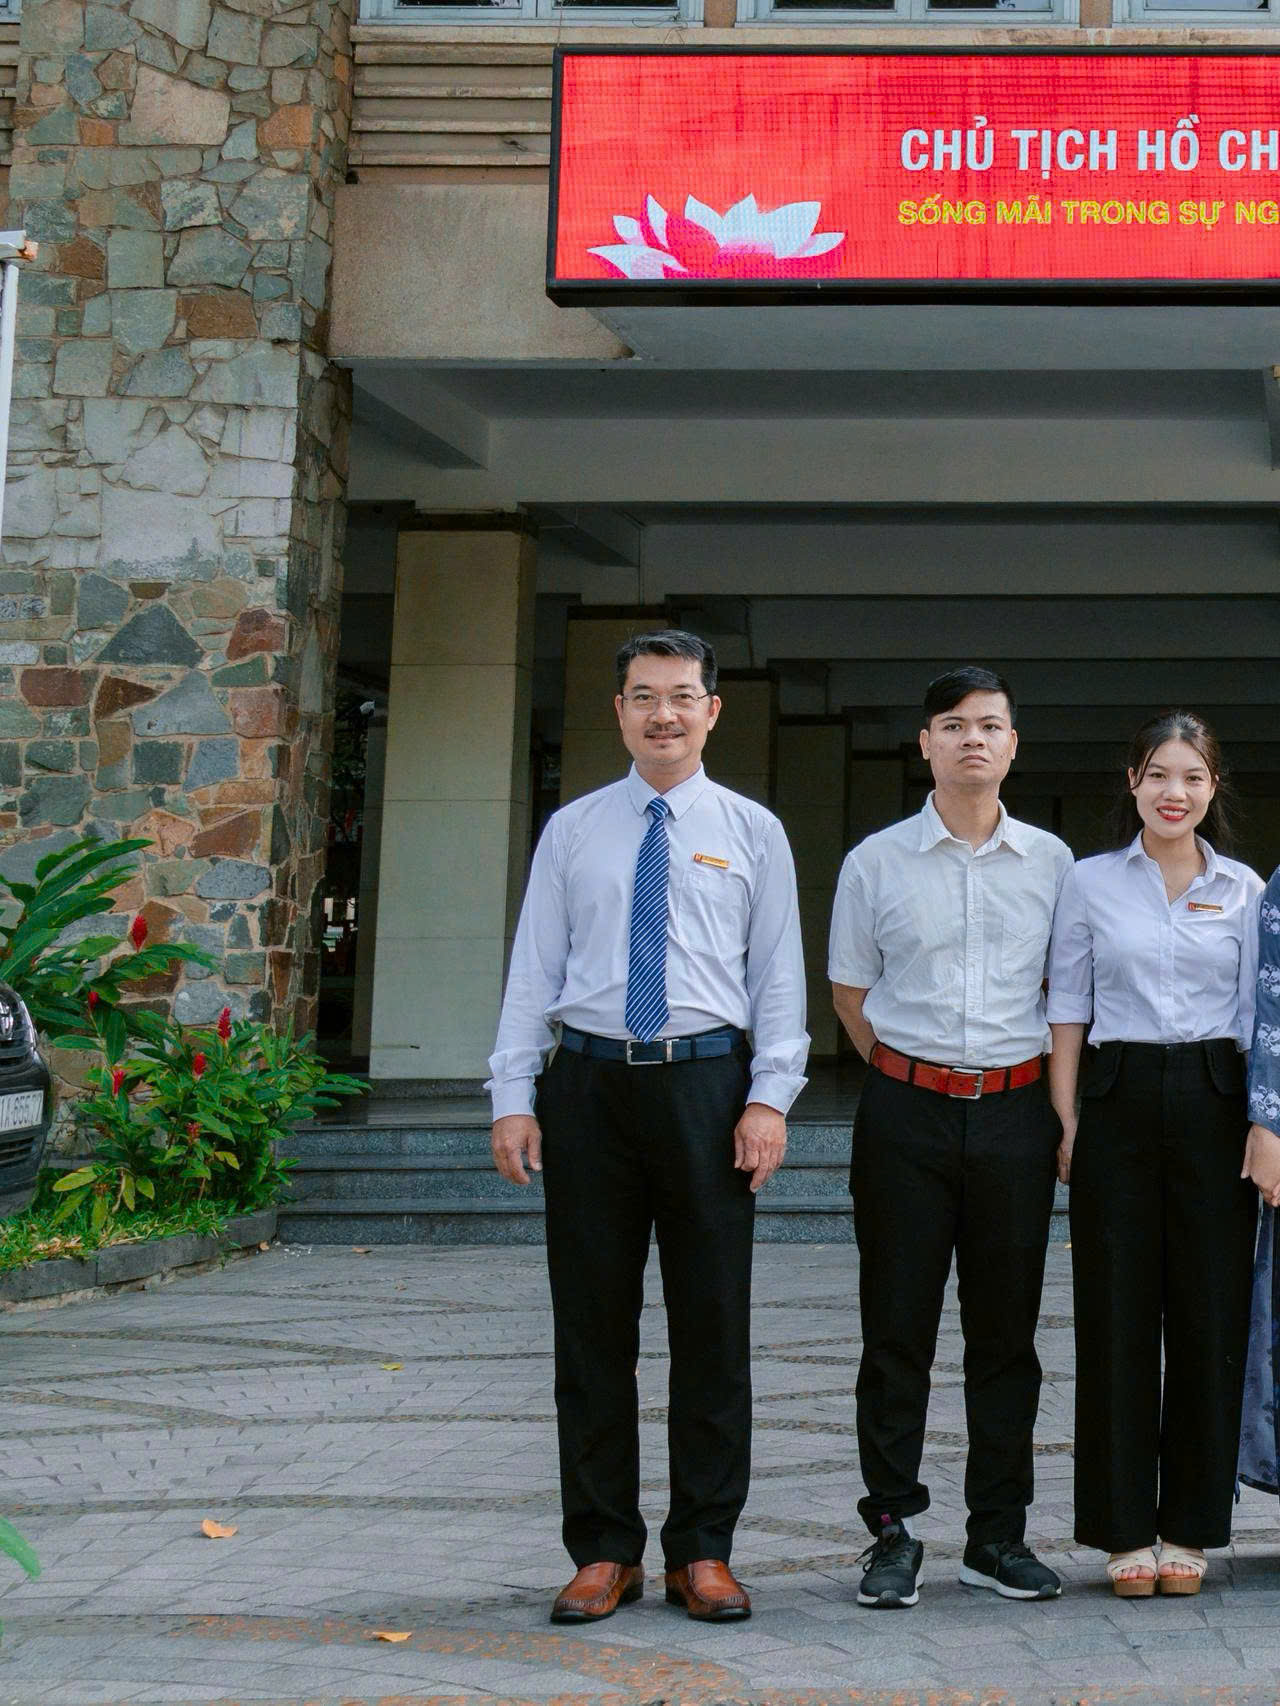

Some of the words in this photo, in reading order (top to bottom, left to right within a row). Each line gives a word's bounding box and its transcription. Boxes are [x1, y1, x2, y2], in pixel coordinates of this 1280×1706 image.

[901, 115, 994, 171] CHỦ
[1010, 129, 1117, 180] TỊCH
[1137, 114, 1200, 171] HỒ
[898, 193, 987, 225] SỐNG
[996, 194, 1052, 225] MÃI
[1060, 200, 1170, 225] TRONG
[1178, 200, 1226, 231] SỰ
